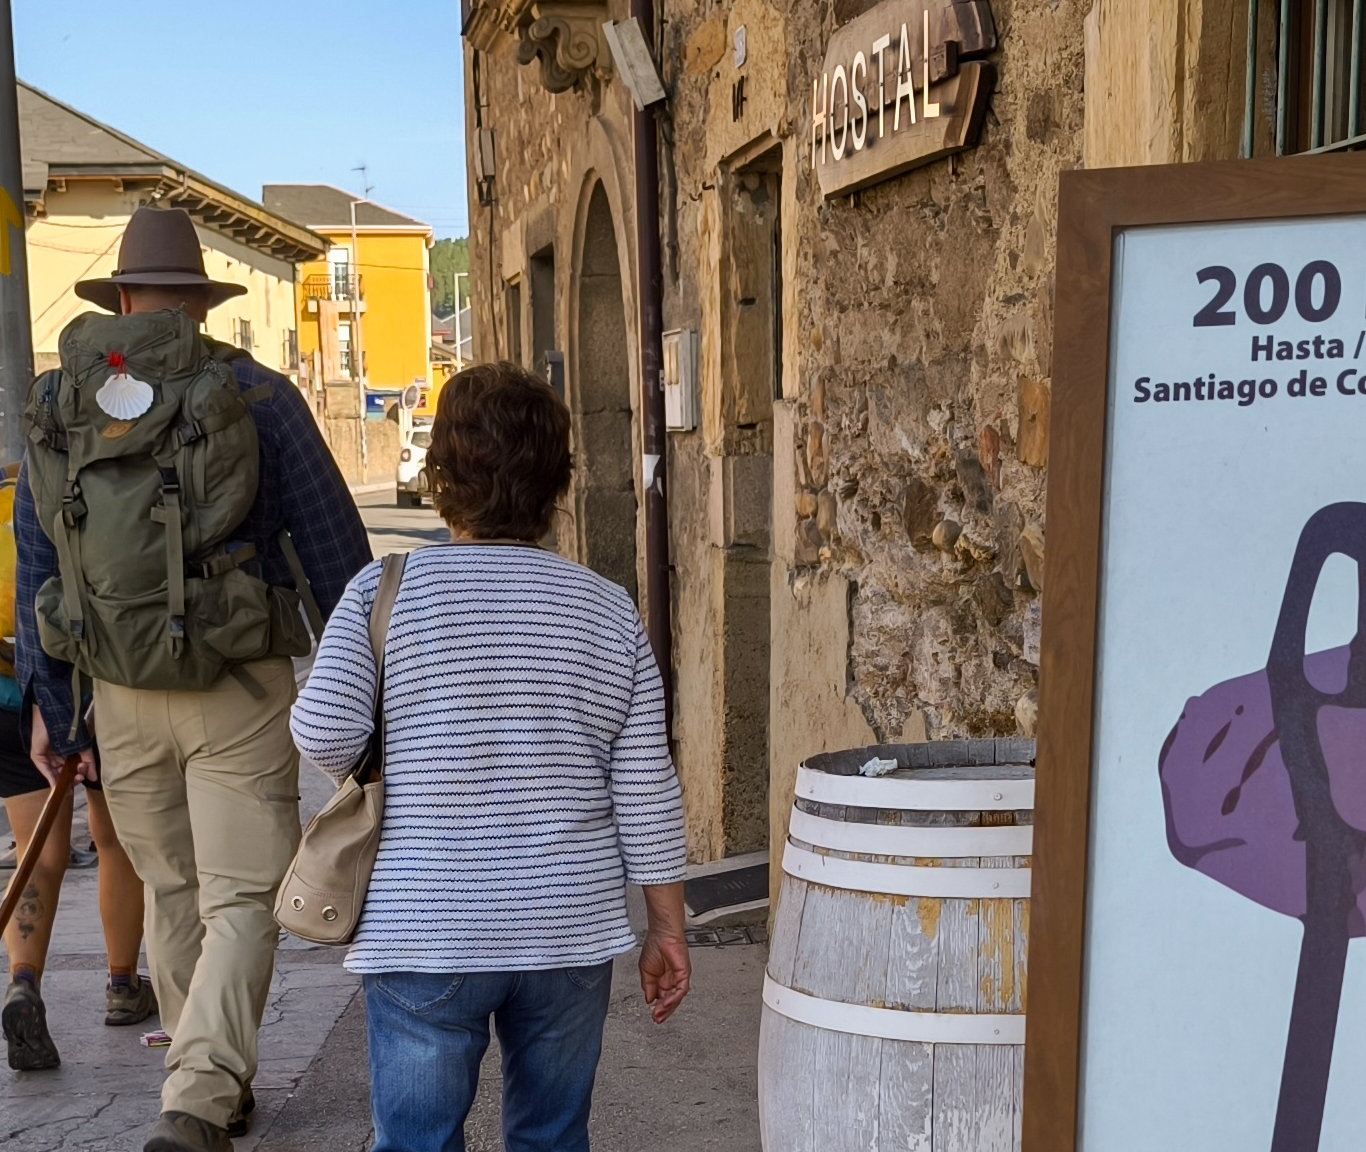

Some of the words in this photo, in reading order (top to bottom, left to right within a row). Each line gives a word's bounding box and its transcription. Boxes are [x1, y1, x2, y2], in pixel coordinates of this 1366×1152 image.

[811, 9, 940, 170] HOSTAL
[1193, 260, 1342, 327] 200
[1250, 333, 1345, 362] Hasta
[1353, 331, 1366, 359] /
[1133, 373, 1278, 406] Santiago
[1286, 370, 1328, 397] de
